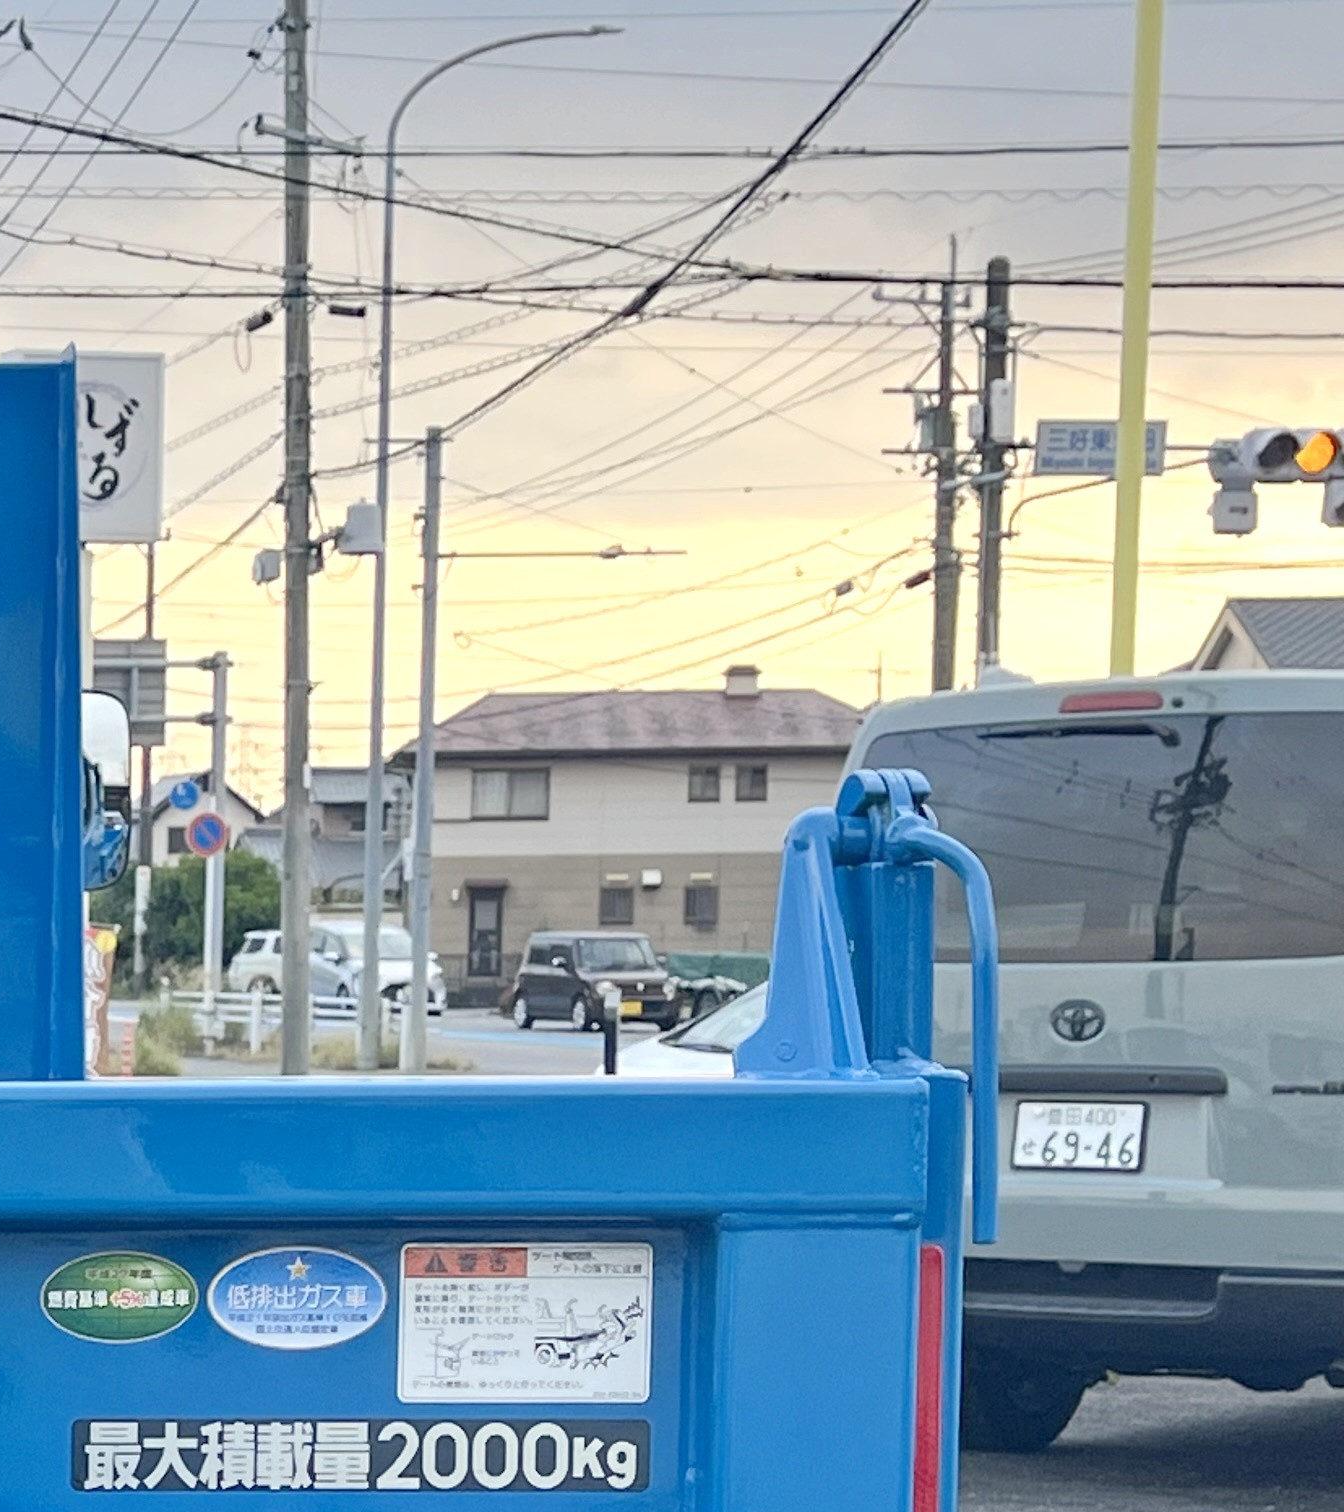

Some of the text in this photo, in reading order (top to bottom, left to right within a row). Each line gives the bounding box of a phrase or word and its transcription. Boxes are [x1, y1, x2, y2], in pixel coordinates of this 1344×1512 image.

[1041, 1131, 1135, 1166] 69-46
[227, 1285, 369, 1310] 低排出ガス車
